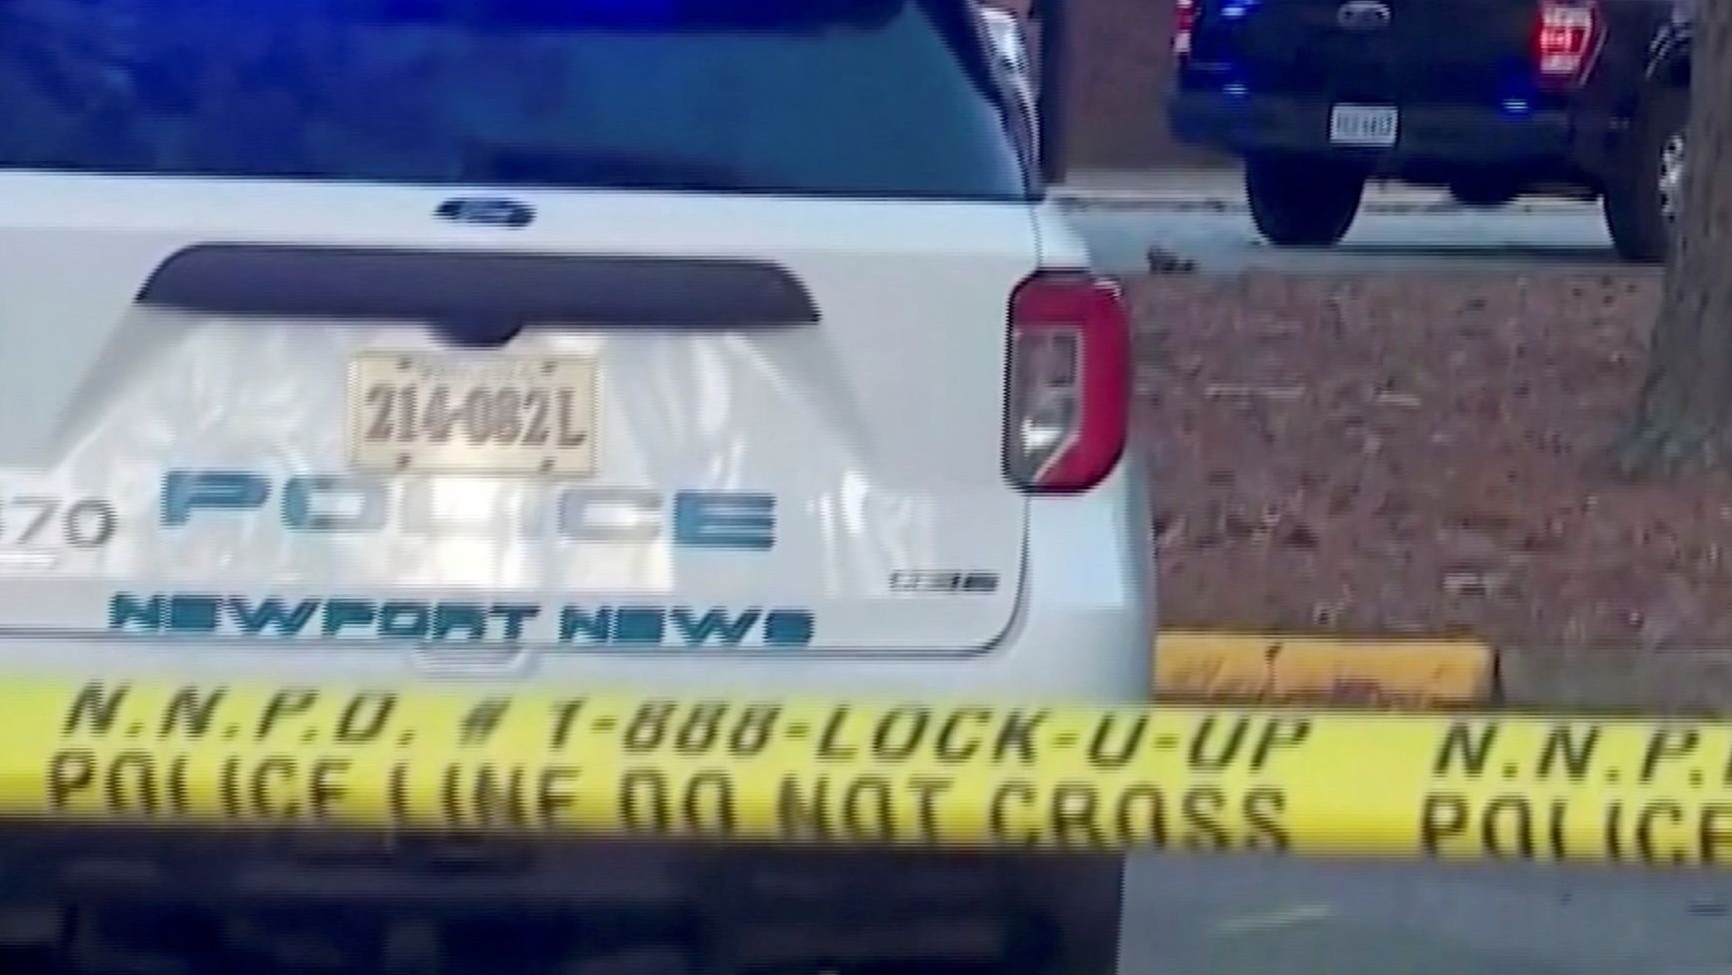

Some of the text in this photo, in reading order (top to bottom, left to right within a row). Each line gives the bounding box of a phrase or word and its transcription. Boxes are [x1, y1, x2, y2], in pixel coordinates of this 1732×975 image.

[364, 382, 587, 447] 214-082L
[0, 494, 117, 549] 70
[160, 470, 777, 550] POLICE
[110, 592, 814, 646] NEWPORT NEWS
[64, 681, 415, 748] N.N.P.D.
[546, 696, 1312, 772] 1-888-LOCK-U-UP
[46, 748, 1290, 854] POLICE LINE DO NOT CROSS
